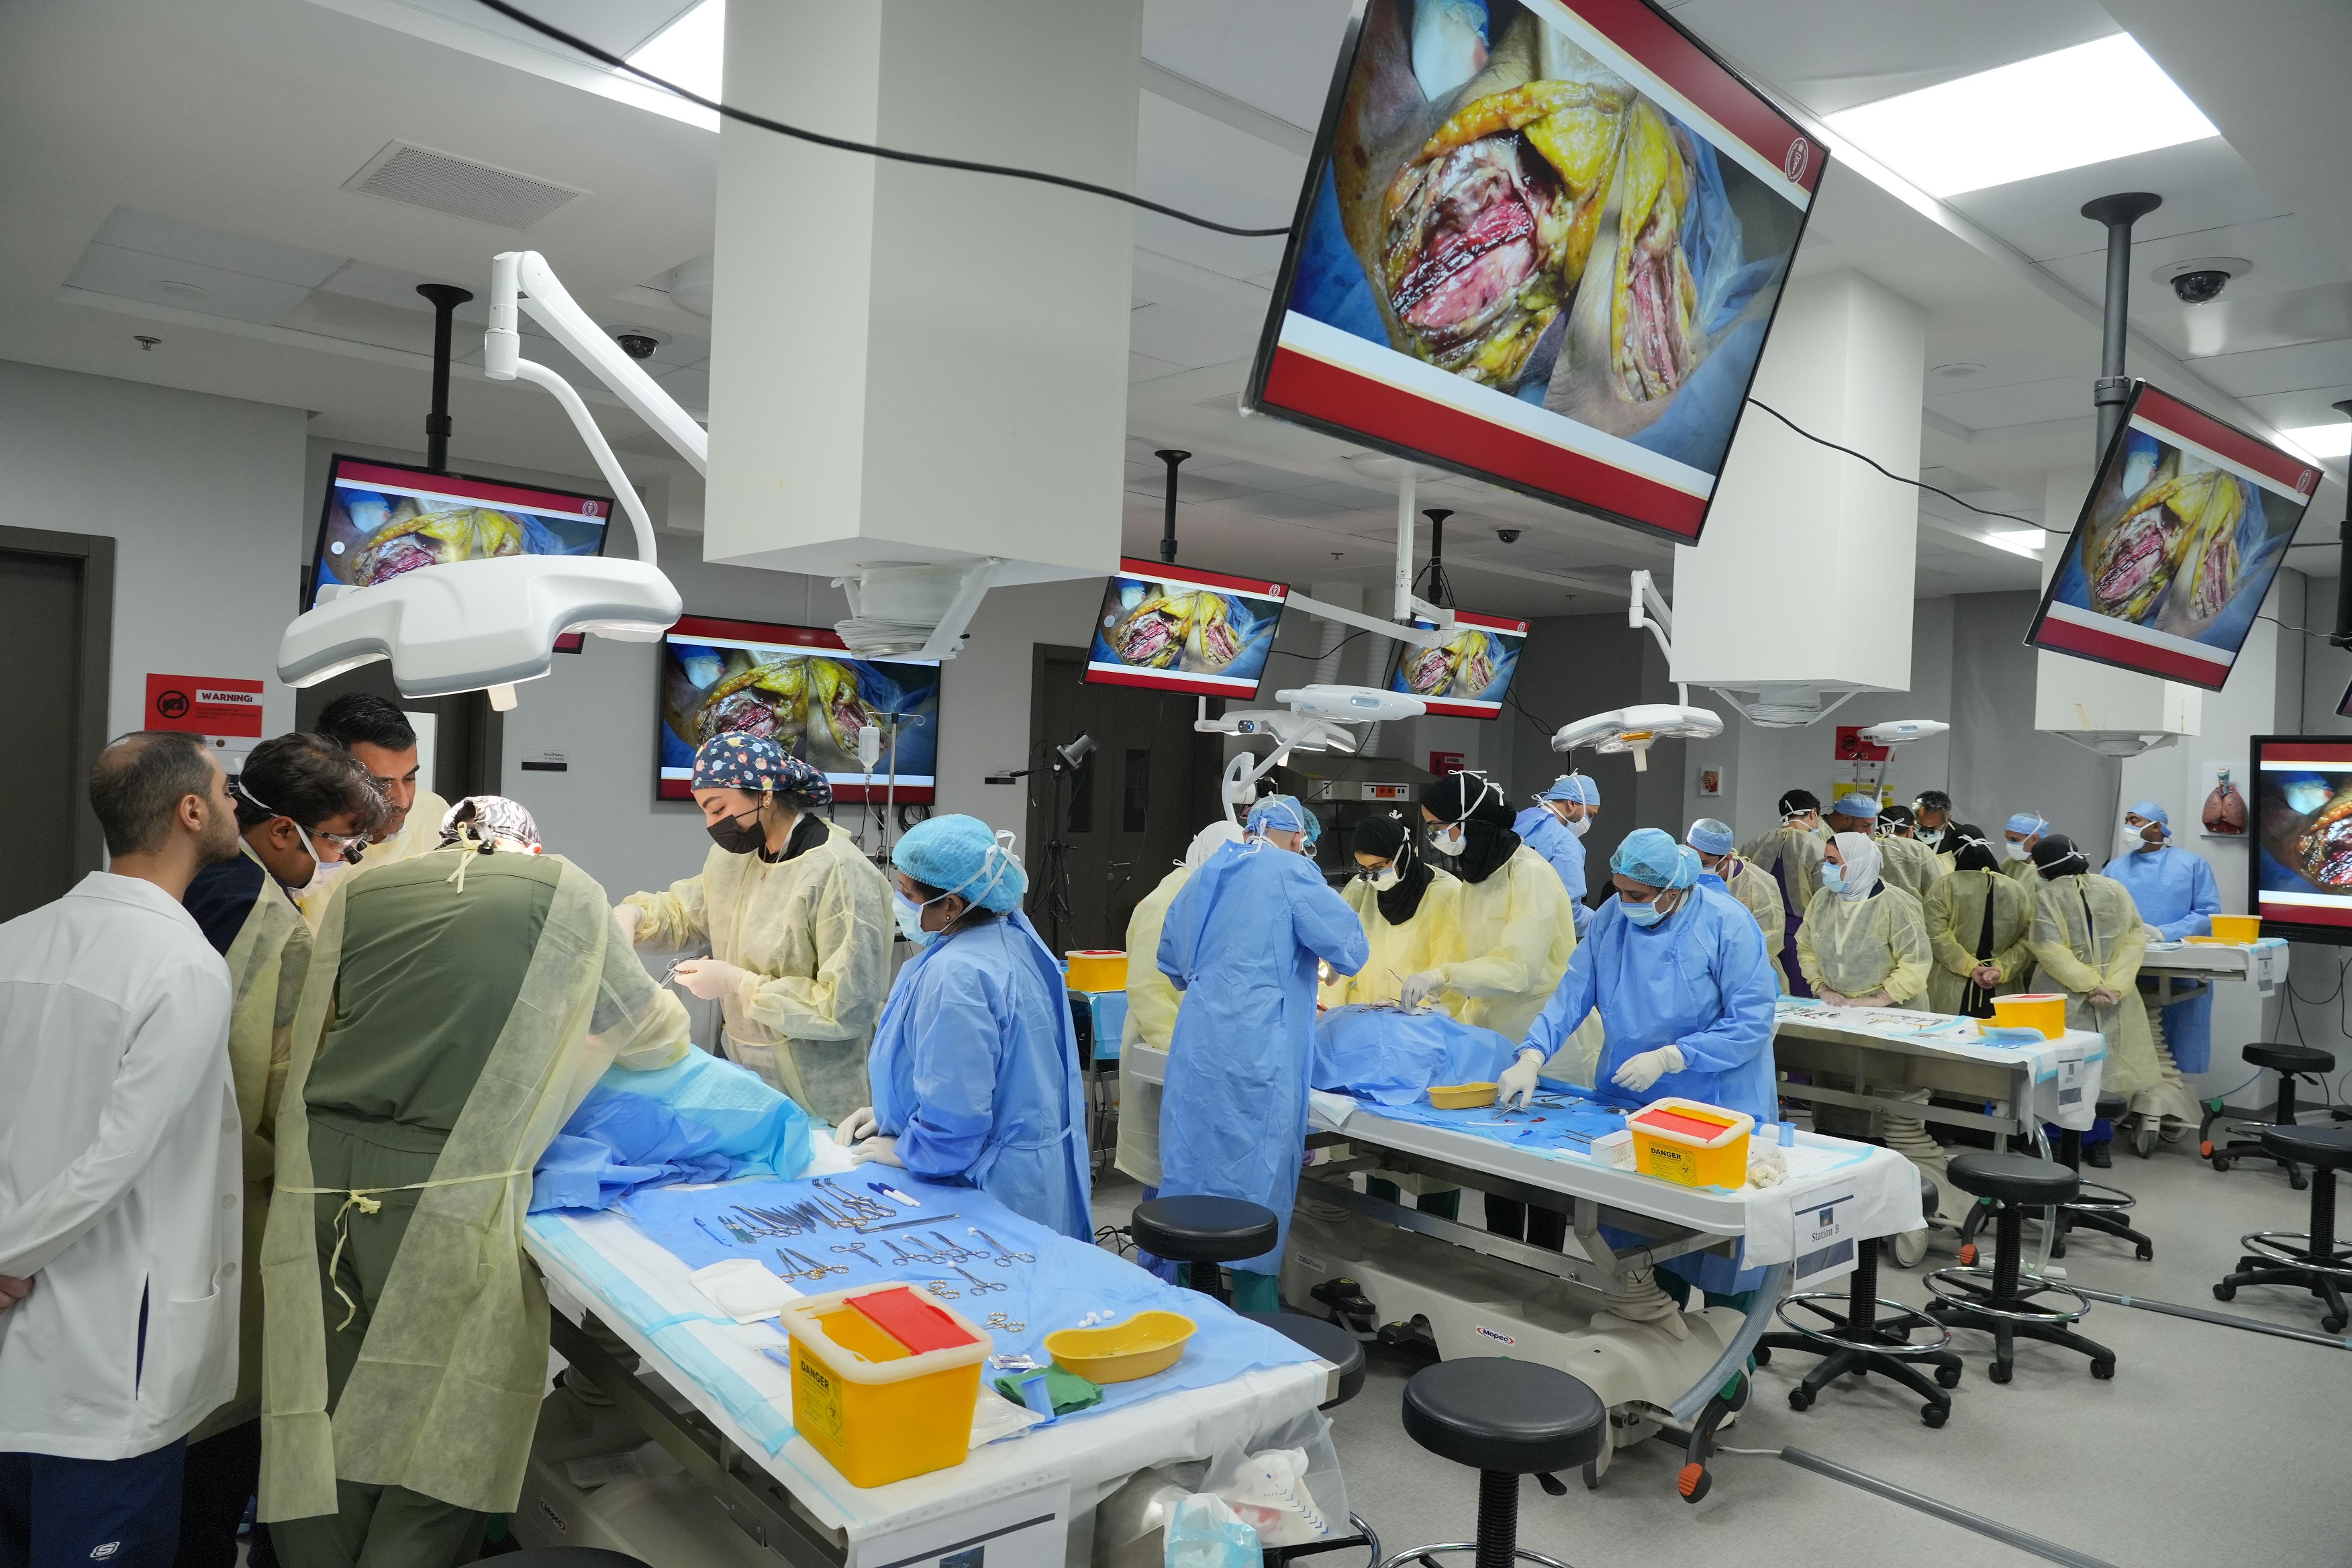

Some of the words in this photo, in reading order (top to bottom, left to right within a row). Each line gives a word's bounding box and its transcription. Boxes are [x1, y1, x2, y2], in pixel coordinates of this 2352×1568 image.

[1651, 1148, 1681, 1160] DANGER
[1812, 1228, 1833, 1242] Station
[1835, 1224, 1839, 1234] B
[1483, 1328, 1508, 1342] Mopec
[801, 1361, 830, 1391] DANGER
